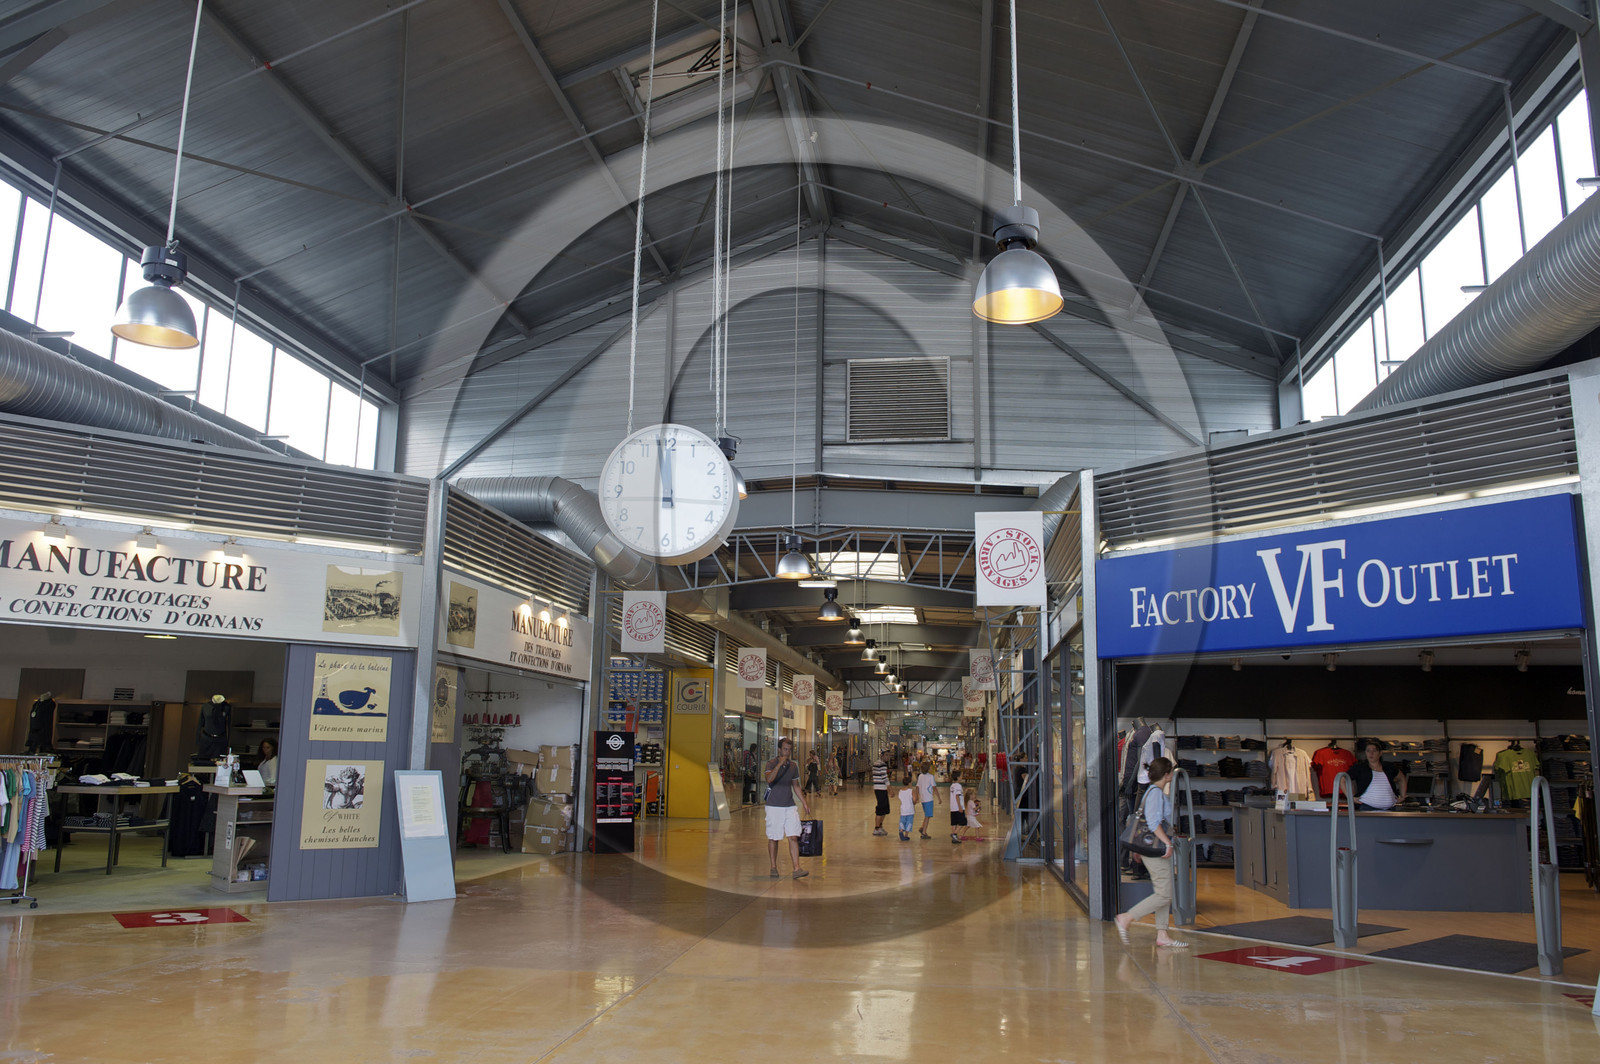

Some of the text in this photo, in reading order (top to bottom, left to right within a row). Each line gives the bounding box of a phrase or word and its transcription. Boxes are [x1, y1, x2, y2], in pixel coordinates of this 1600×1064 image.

[641, 444, 649, 457] 11
[664, 437, 676, 451] 12
[690, 444, 696, 458] 1
[621, 461, 635, 474] 10
[707, 462, 716, 475] 2
[614, 484, 623, 498] 9
[713, 486, 721, 499] 3
[620, 508, 628, 521] 8
[705, 511, 714, 523] 4
[636, 527, 644, 540] 7
[661, 533, 670, 546] 6
[686, 527, 695, 540] 5
[1005, 530, 1039, 564] STOCK
[981, 538, 1028, 587] ARRIVAGES
[1130, 539, 1518, 634] FACTORY VF OUTLET
[35, 581, 212, 609] DES TRICOTAGES
[9, 598, 264, 632] CONFECTIONS D'ORNANS
[511, 610, 574, 648] MANUFACTURE
[509, 651, 518, 662] ET
[314, 723, 354, 733] Vêtements
[322, 825, 360, 834] Les belles
[304, 834, 376, 844] chemises blanches
